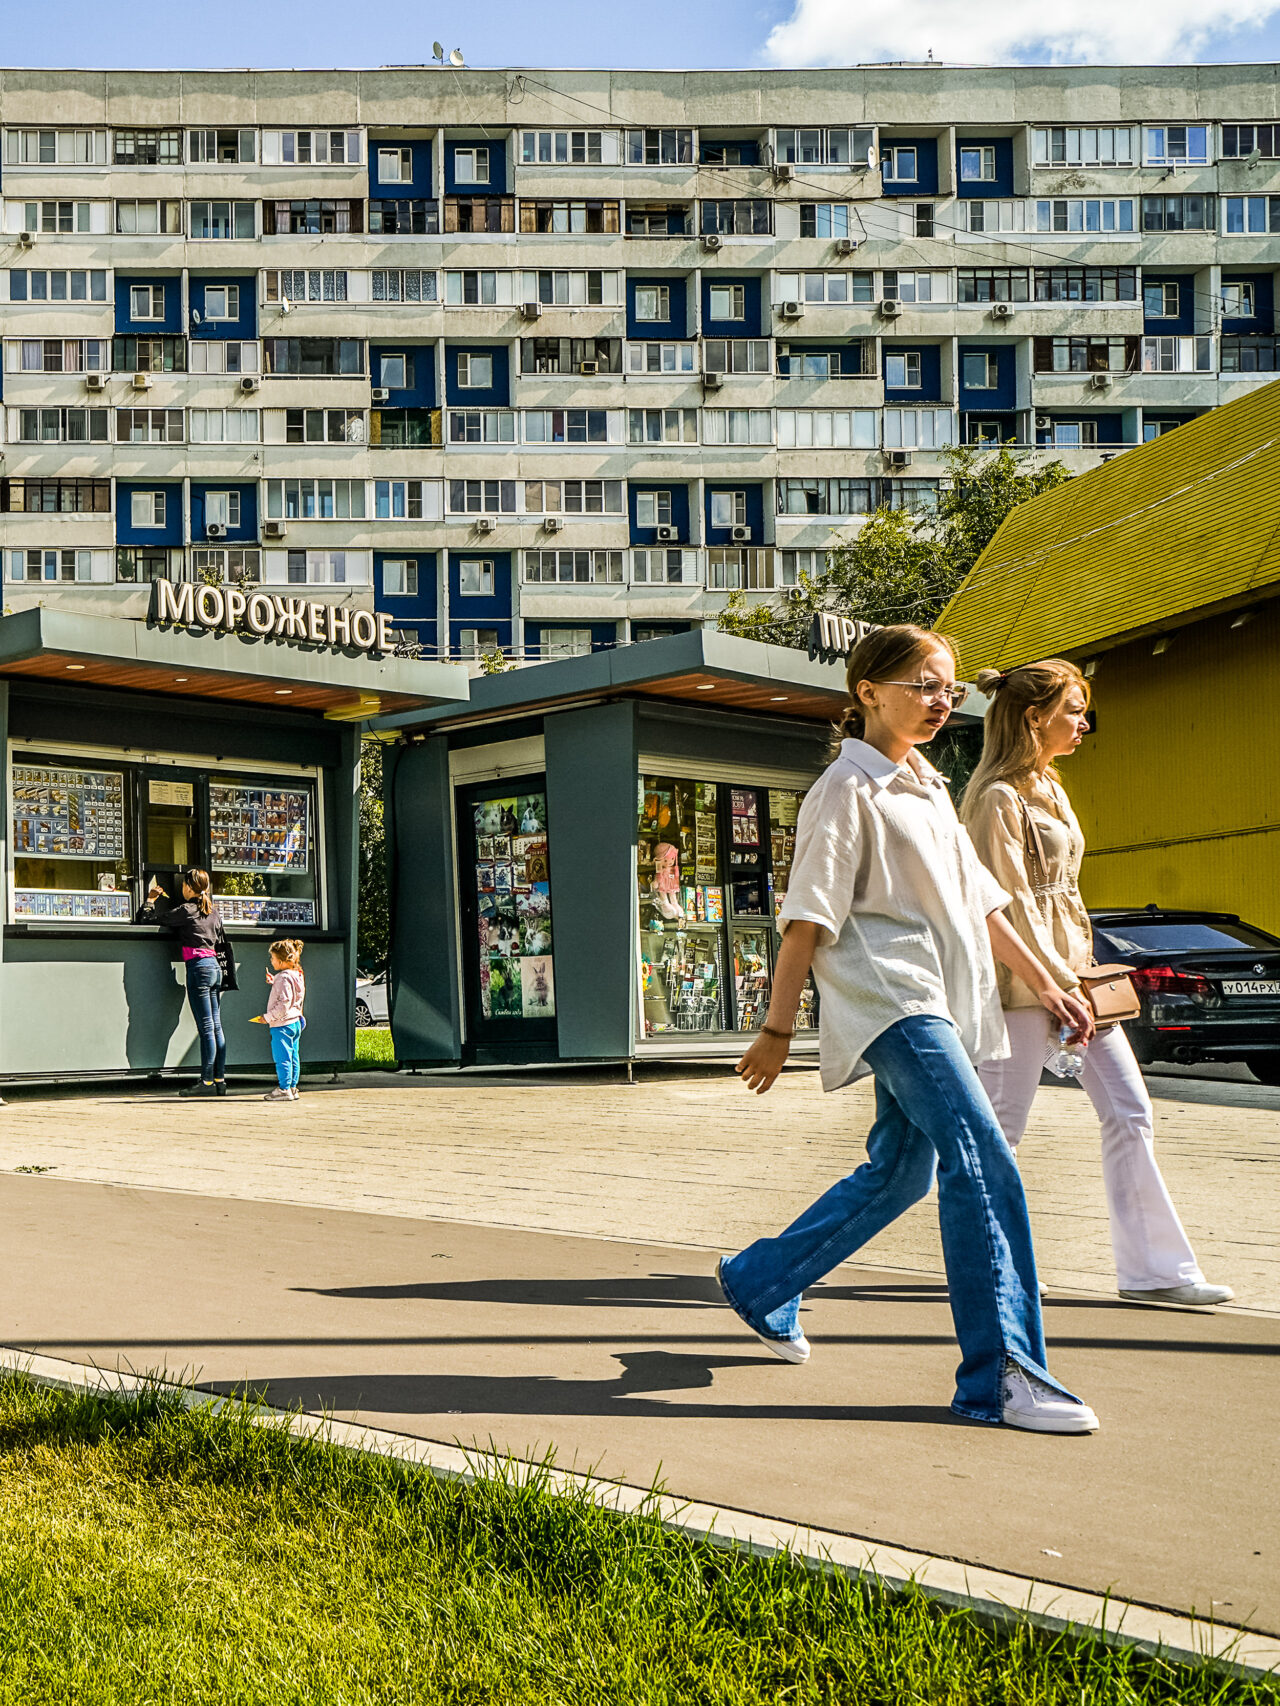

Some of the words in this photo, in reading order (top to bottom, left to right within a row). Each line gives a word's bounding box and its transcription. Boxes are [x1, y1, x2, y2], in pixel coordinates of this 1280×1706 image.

[156, 578, 397, 651] МОРОЖЕНОЕ
[818, 611, 884, 652] ПРЕ
[217, 951, 226, 959] CK
